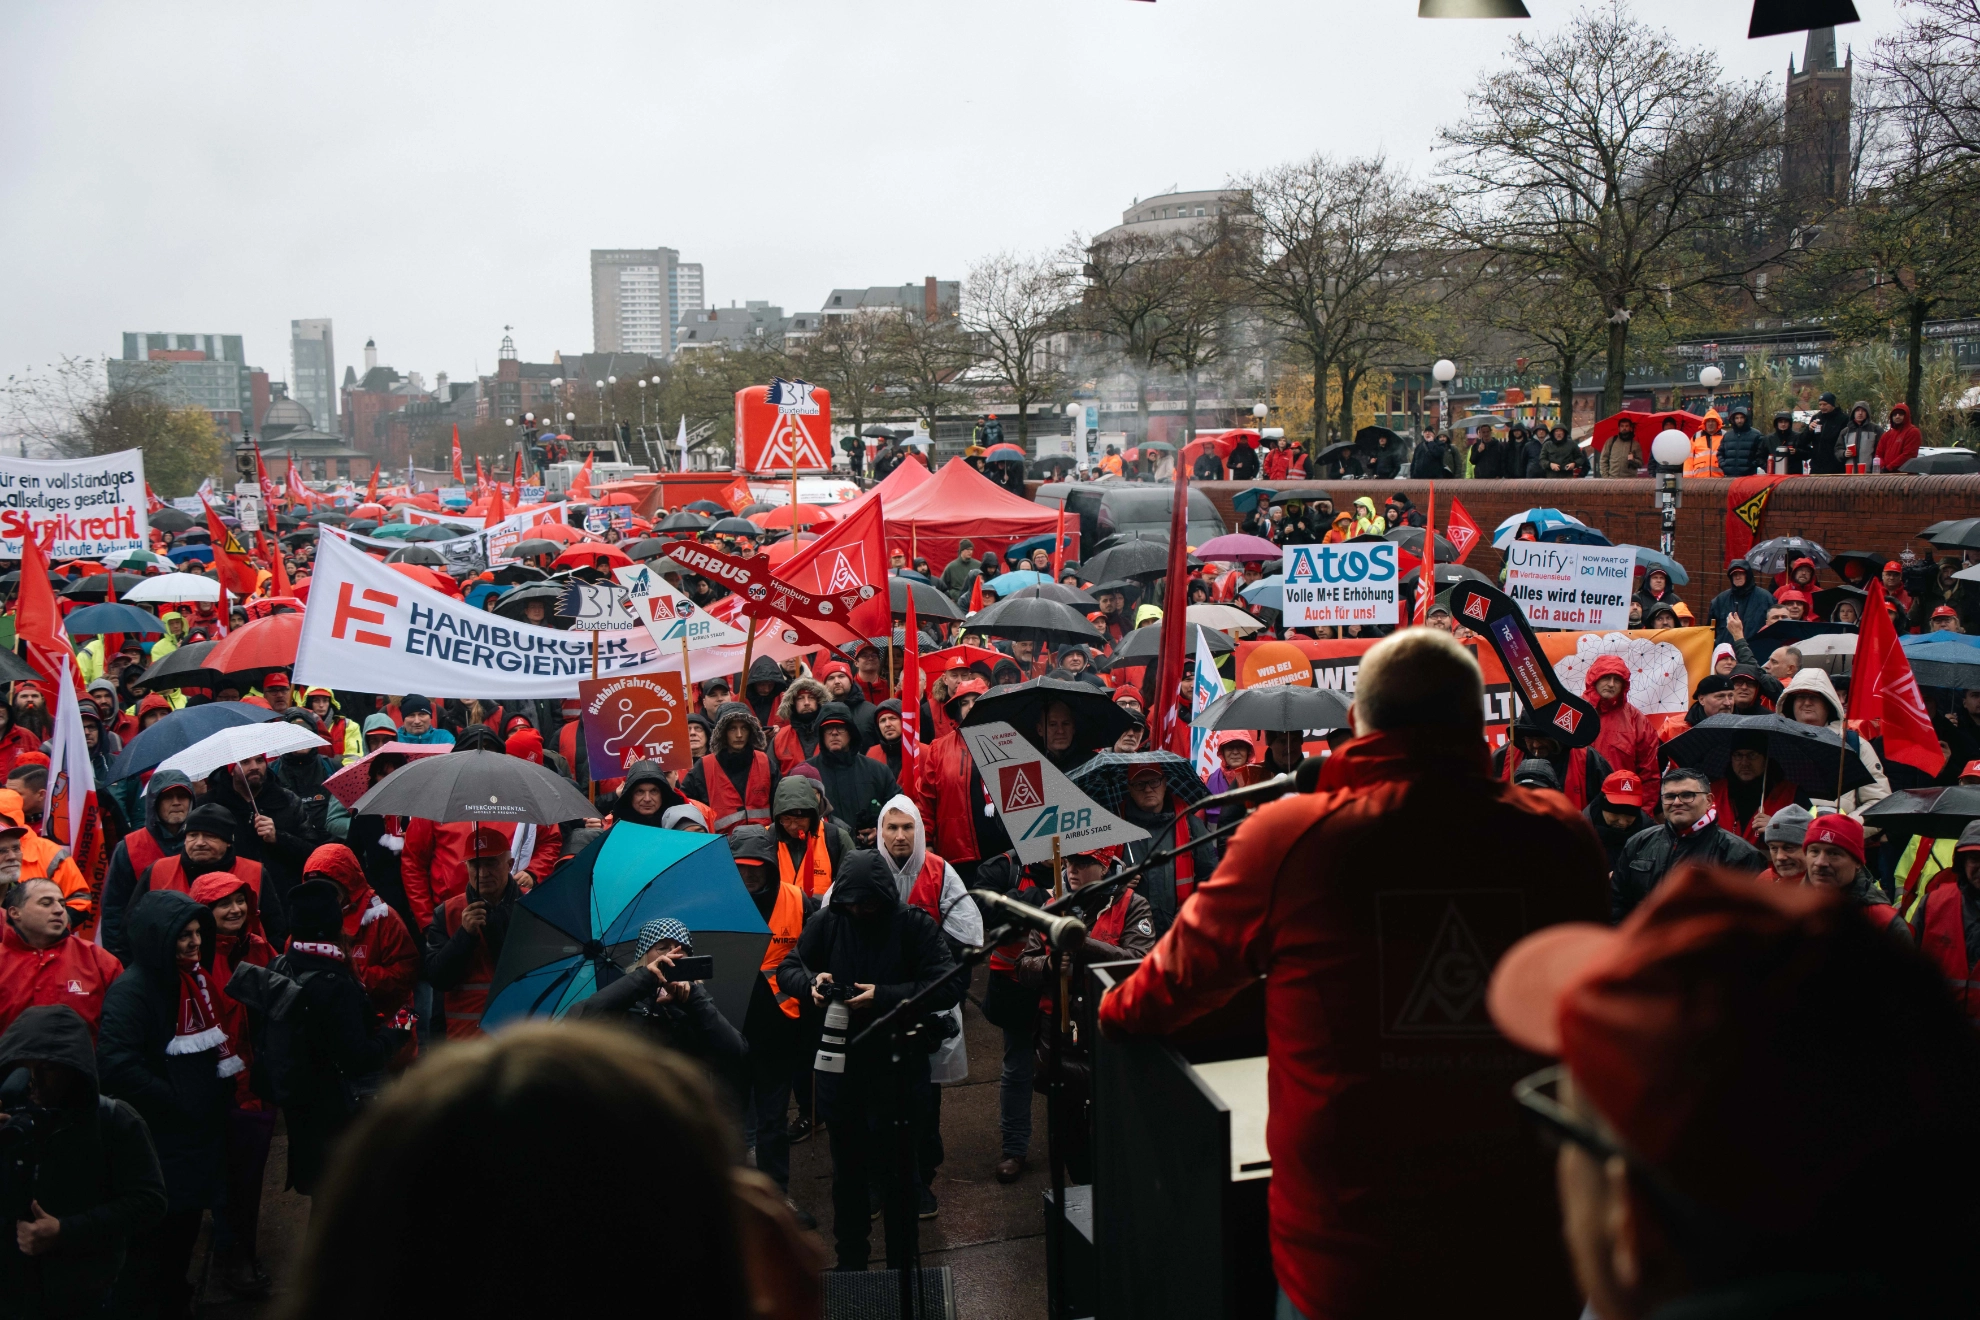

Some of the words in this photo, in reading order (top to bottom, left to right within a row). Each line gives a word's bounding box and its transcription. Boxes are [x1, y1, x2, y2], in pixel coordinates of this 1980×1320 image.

[779, 406, 819, 415] Buxtehude
[20, 474, 40, 488] ein
[46, 470, 135, 490] vollständiges
[75, 489, 125, 510] gesetzl.
[1, 505, 140, 541] Streikrecht
[669, 545, 751, 584] AIRBUS
[1511, 548, 1569, 574] Unify
[1582, 555, 1599, 563] NOW
[1601, 555, 1618, 564] PART
[1520, 570, 1571, 582] Vertrauensleute
[1597, 566, 1627, 578] Mitel
[770, 580, 811, 605] Hamburg
[1286, 587, 1317, 603] Volle
[1317, 587, 1340, 602] M+E
[1344, 586, 1394, 604] Erhöhung
[1510, 584, 1543, 600] Alles
[1548, 587, 1577, 604] wird
[1581, 590, 1625, 607] teurer.
[1304, 606, 1331, 621] Auch
[1335, 605, 1350, 620] für
[1354, 605, 1376, 619] uns!
[1529, 604, 1549, 620] Ich
[1553, 607, 1585, 623] auch
[1589, 608, 1603, 625] !!!
[410, 602, 628, 656] HAMBURGER
[577, 619, 633, 630] Buxtehude
[688, 621, 711, 637] BR
[405, 627, 658, 676] ENERGIENETZE
[1257, 665, 1277, 678] WIR
[1277, 661, 1292, 673] BEI
[1523, 656, 1549, 700] Fahrtreppen
[1517, 665, 1539, 699] Hamburg
[588, 677, 677, 715] #ichbinFahrtreppe
[999, 731, 1017, 739] AIRBUS
[1060, 807, 1092, 833] BR
[1065, 829, 1090, 840] AIRBUS
[1090, 824, 1112, 834] STADE
